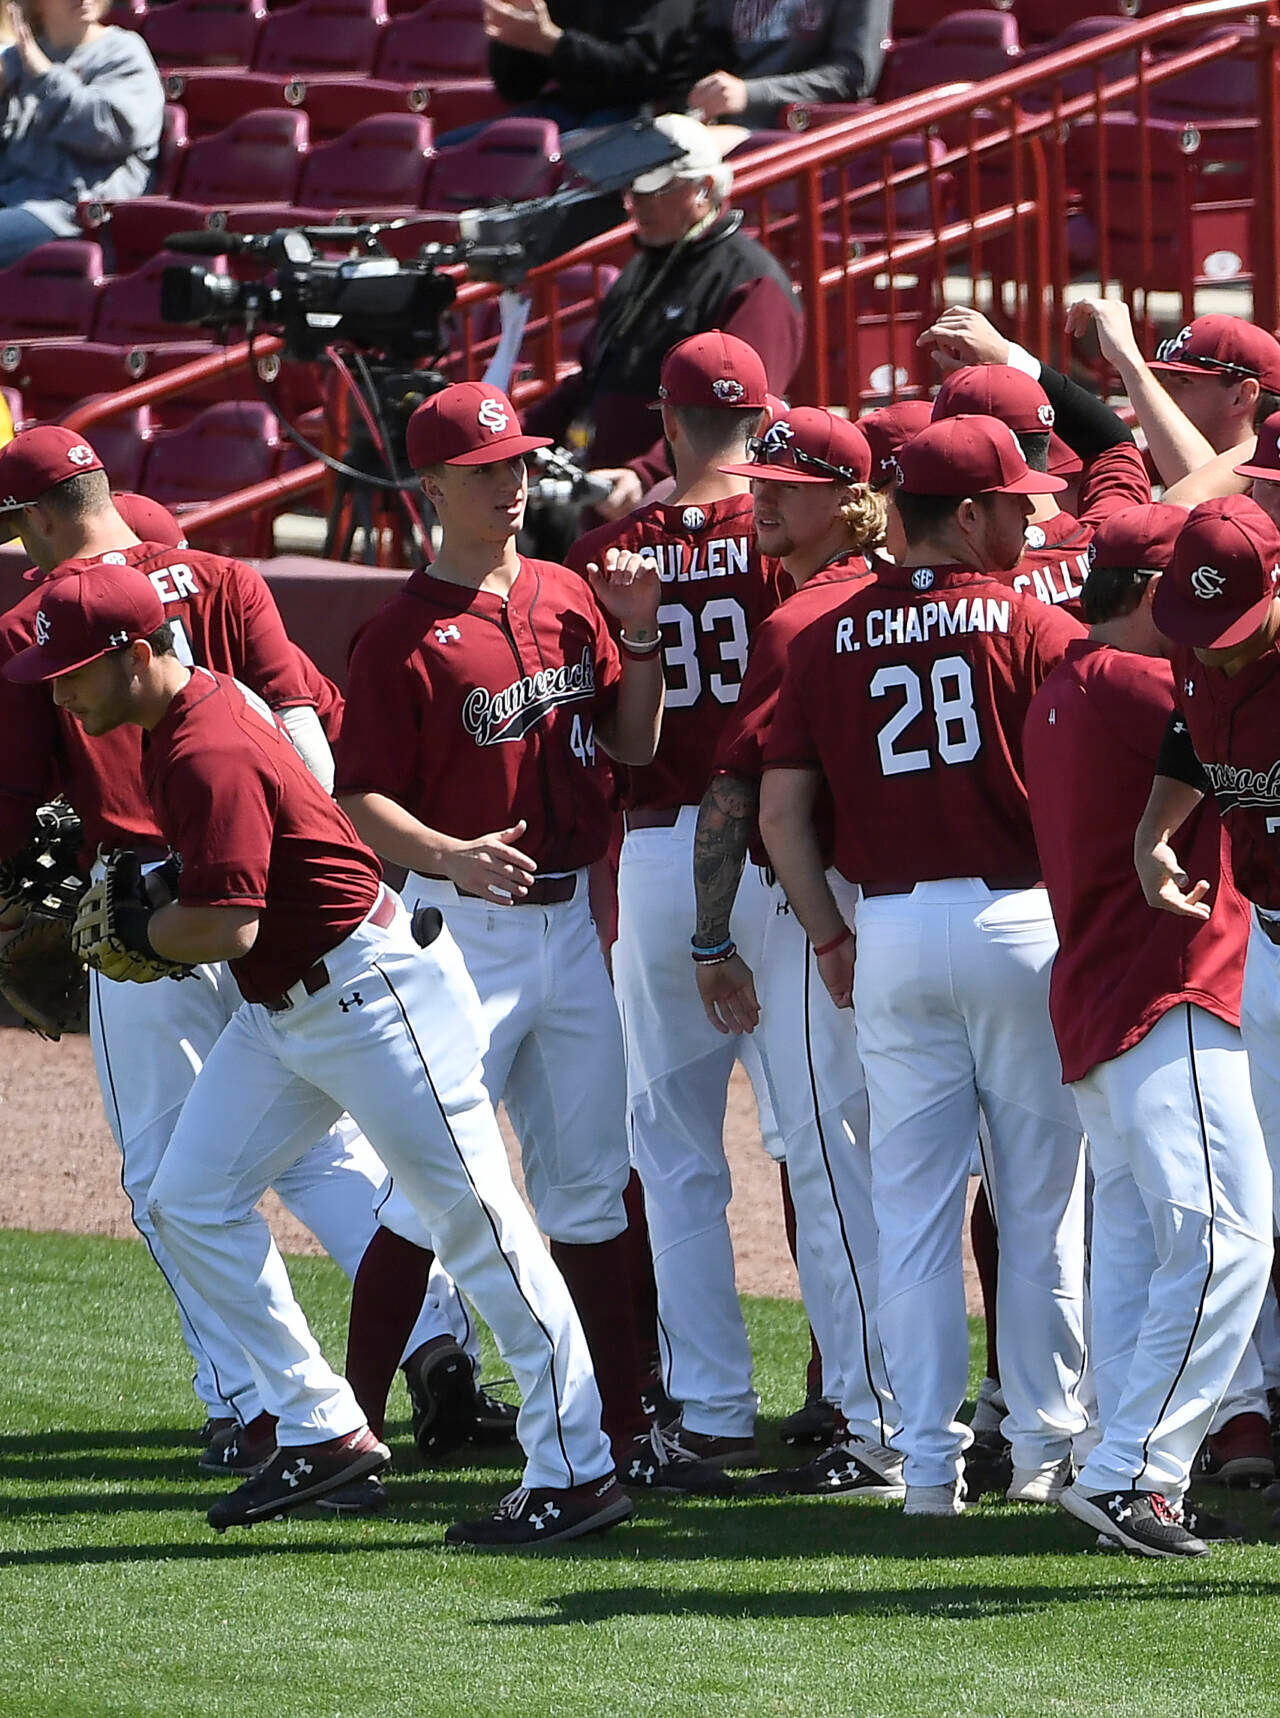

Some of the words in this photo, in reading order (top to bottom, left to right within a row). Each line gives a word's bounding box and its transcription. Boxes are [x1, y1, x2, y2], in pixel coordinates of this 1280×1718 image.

[836, 617, 861, 653] R.
[866, 598, 1010, 648] CHAPMAN
[912, 569, 934, 589] SEC
[462, 646, 596, 746] Gamecock
[656, 598, 750, 708] 33
[870, 655, 982, 776] 28
